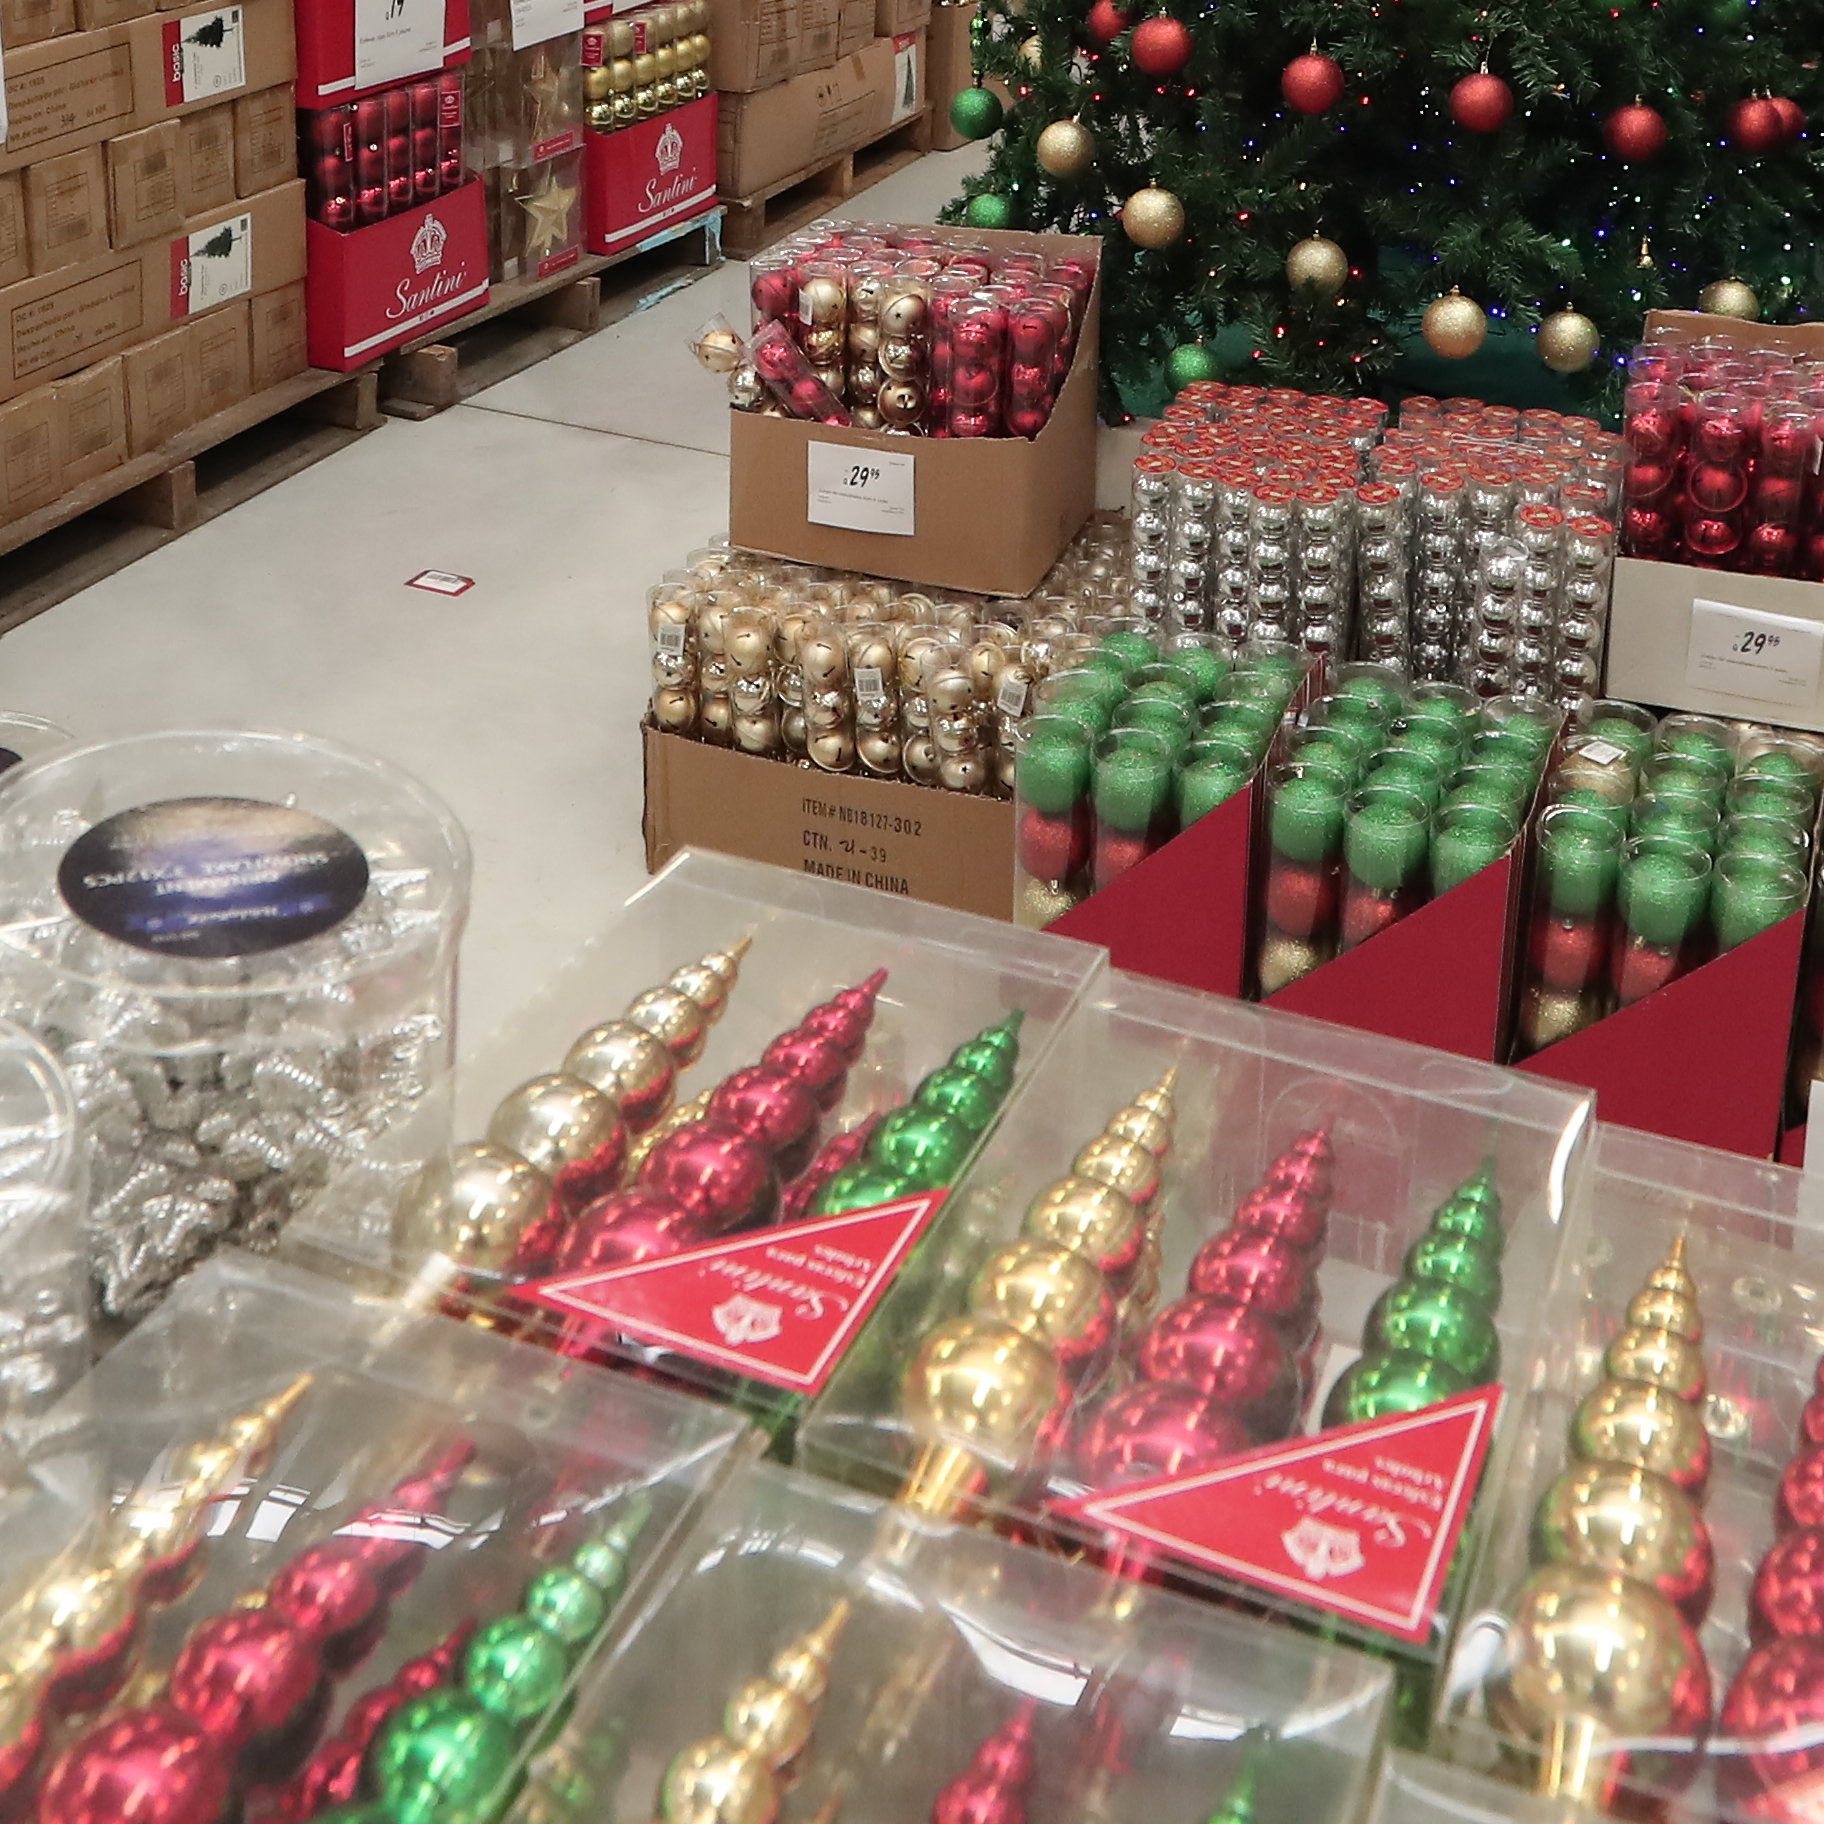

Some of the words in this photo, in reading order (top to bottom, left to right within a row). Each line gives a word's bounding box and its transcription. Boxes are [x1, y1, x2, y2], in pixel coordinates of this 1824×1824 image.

[171, 43, 181, 83] basic
[638, 166, 699, 213] Santini
[178, 258, 190, 297] basic
[385, 260, 468, 319] Santini
[803, 829, 833, 852] CTN.
[803, 859, 844, 880] MADE
[847, 869, 862, 885] IN
[865, 872, 910, 895] CHINA
[700, 1258, 851, 1321] Santini
[1252, 1471, 1433, 1549] Santini
